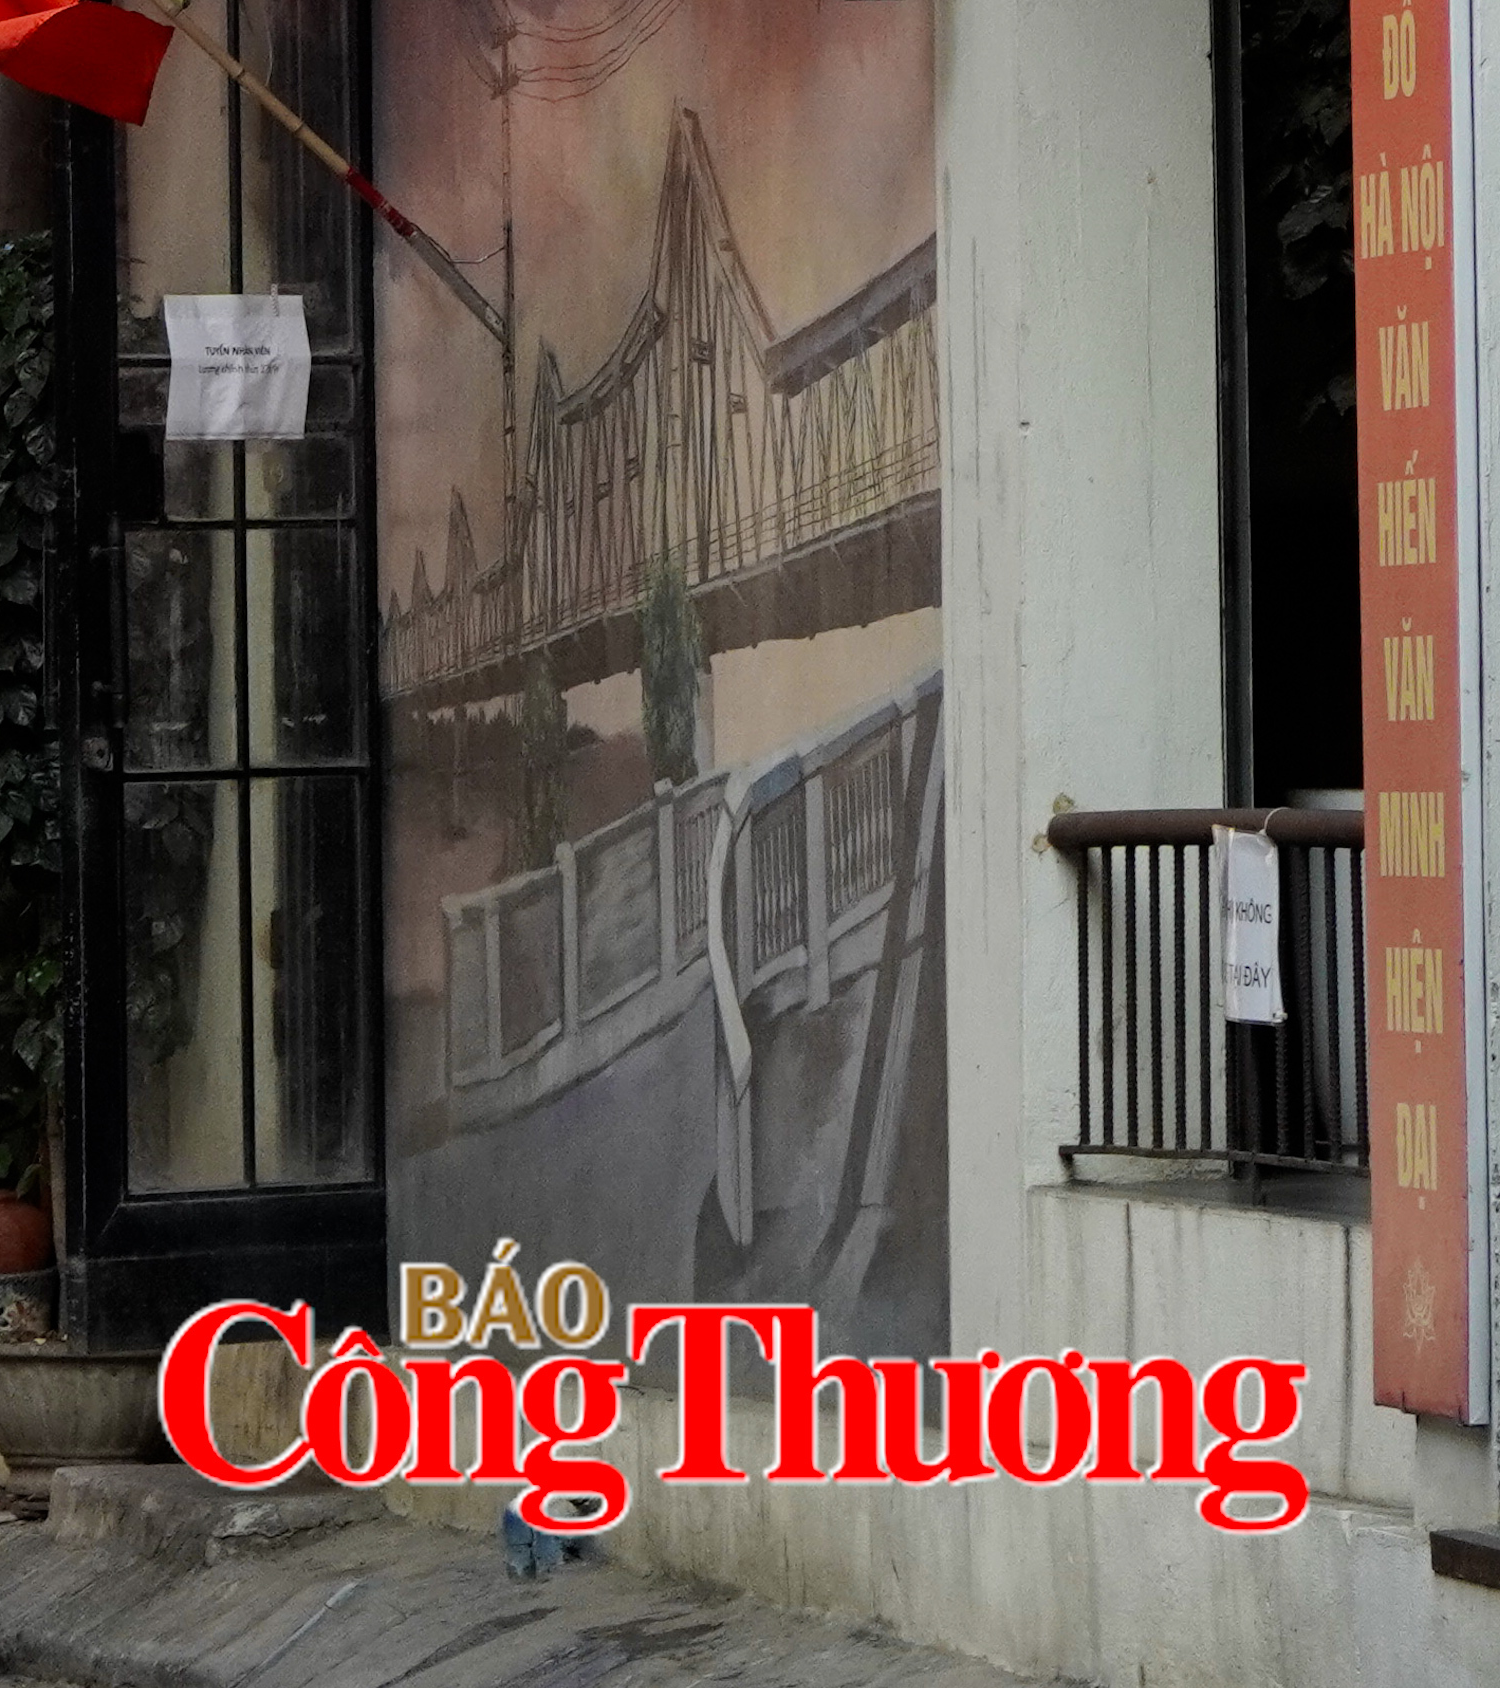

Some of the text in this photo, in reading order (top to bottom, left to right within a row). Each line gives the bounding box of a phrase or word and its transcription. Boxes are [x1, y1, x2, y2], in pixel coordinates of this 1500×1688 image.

[1361, 144, 1445, 271] HÀ NỘI
[1379, 305, 1431, 412] VĂN
[1378, 449, 1438, 567] HIẾN
[1383, 616, 1436, 722] VĂN
[1378, 790, 1446, 878] MINH
[1235, 898, 1273, 924] KHÔNG
[1244, 962, 1272, 988] ĐÂY
[1384, 928, 1444, 1054] HIỆN
[1396, 1102, 1439, 1210] ĐẠI
